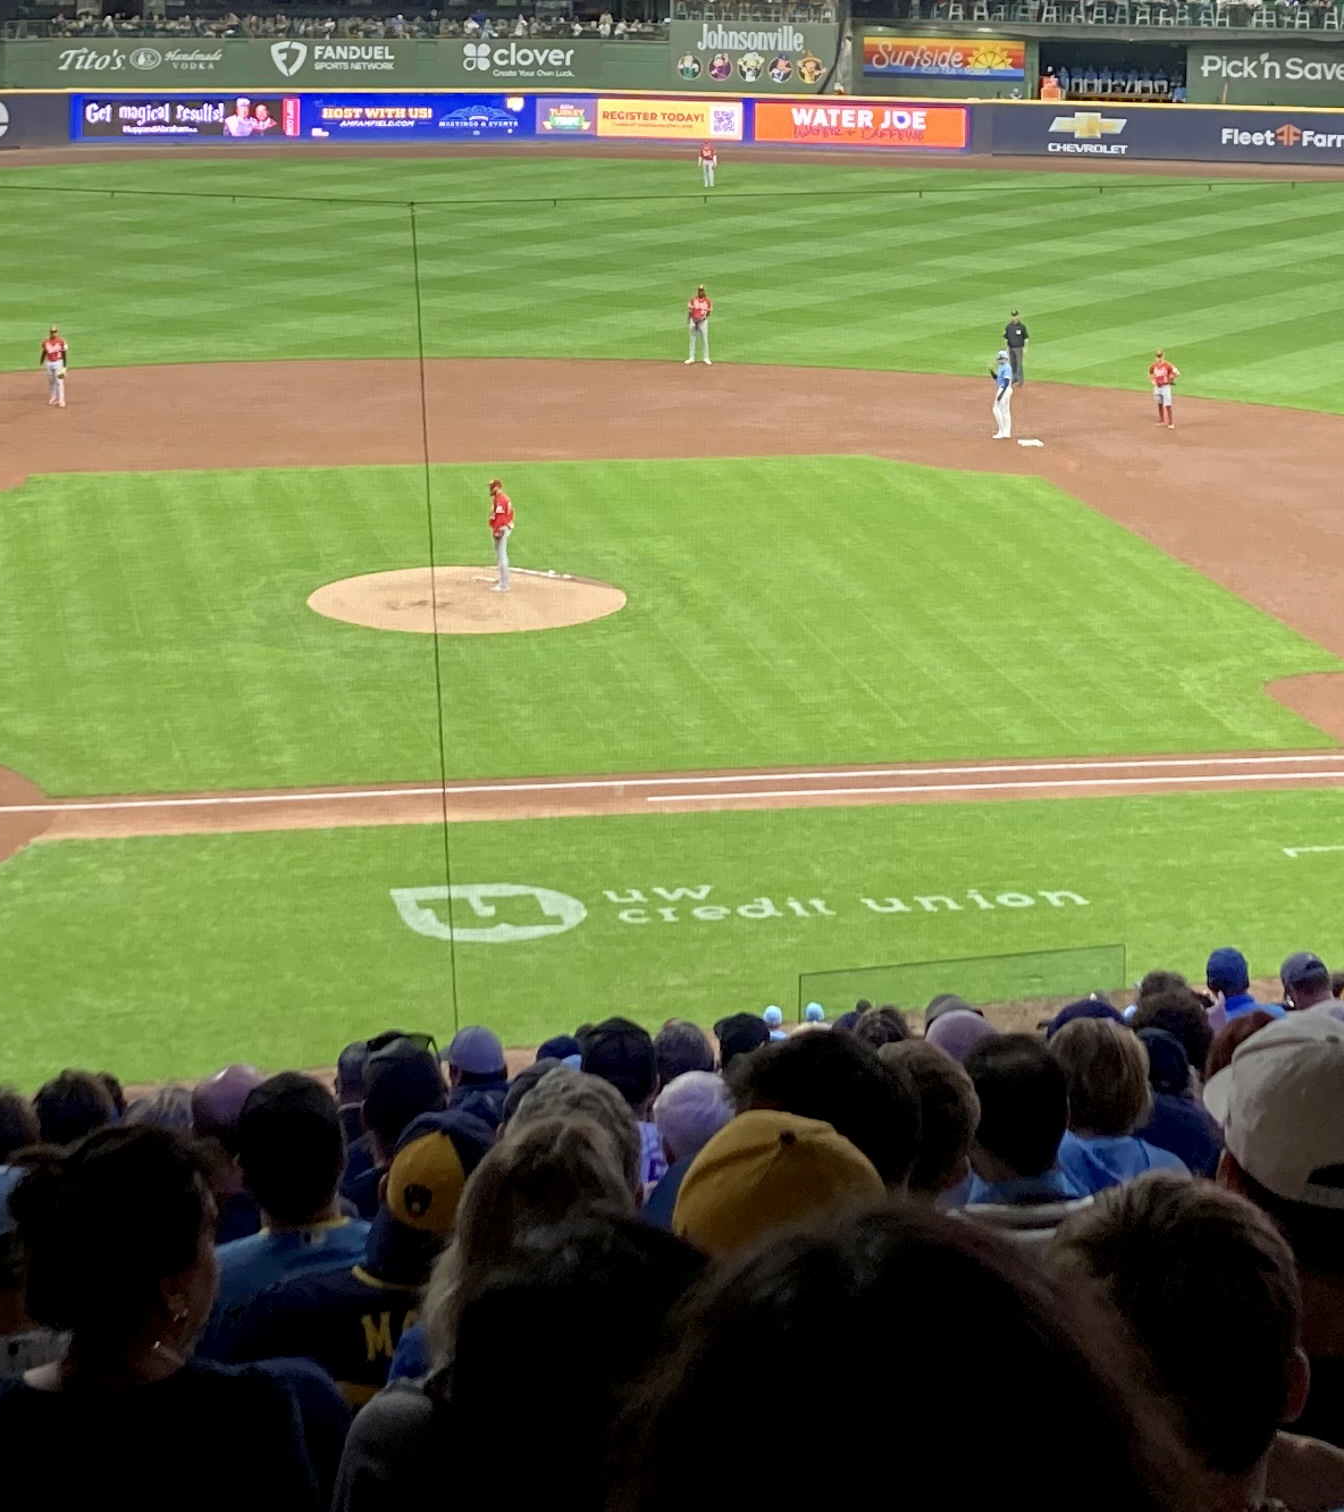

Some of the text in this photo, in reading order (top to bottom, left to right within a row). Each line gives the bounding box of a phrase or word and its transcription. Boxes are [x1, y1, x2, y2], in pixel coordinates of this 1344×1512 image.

[698, 24, 805, 52] Johnsonville
[58, 48, 126, 71] Tito's
[164, 49, 223, 62] Handmade
[314, 44, 395, 60] FANDUEL
[493, 42, 574, 67] clover
[872, 39, 964, 70] Surfside
[172, 62, 215, 70] VODKA
[313, 62, 395, 70] SPORTS NETWORK
[86, 103, 225, 125] Get magical results!
[321, 108, 433, 120] HOST WITH US!
[602, 110, 705, 124] REGISTER TODAY!
[791, 108, 927, 130] WATER JOE
[1222, 128, 1275, 146] Fleet
[1048, 143, 1128, 155] CHEVROLET
[603, 884, 715, 903] uw
[617, 888, 1090, 924] credit union
